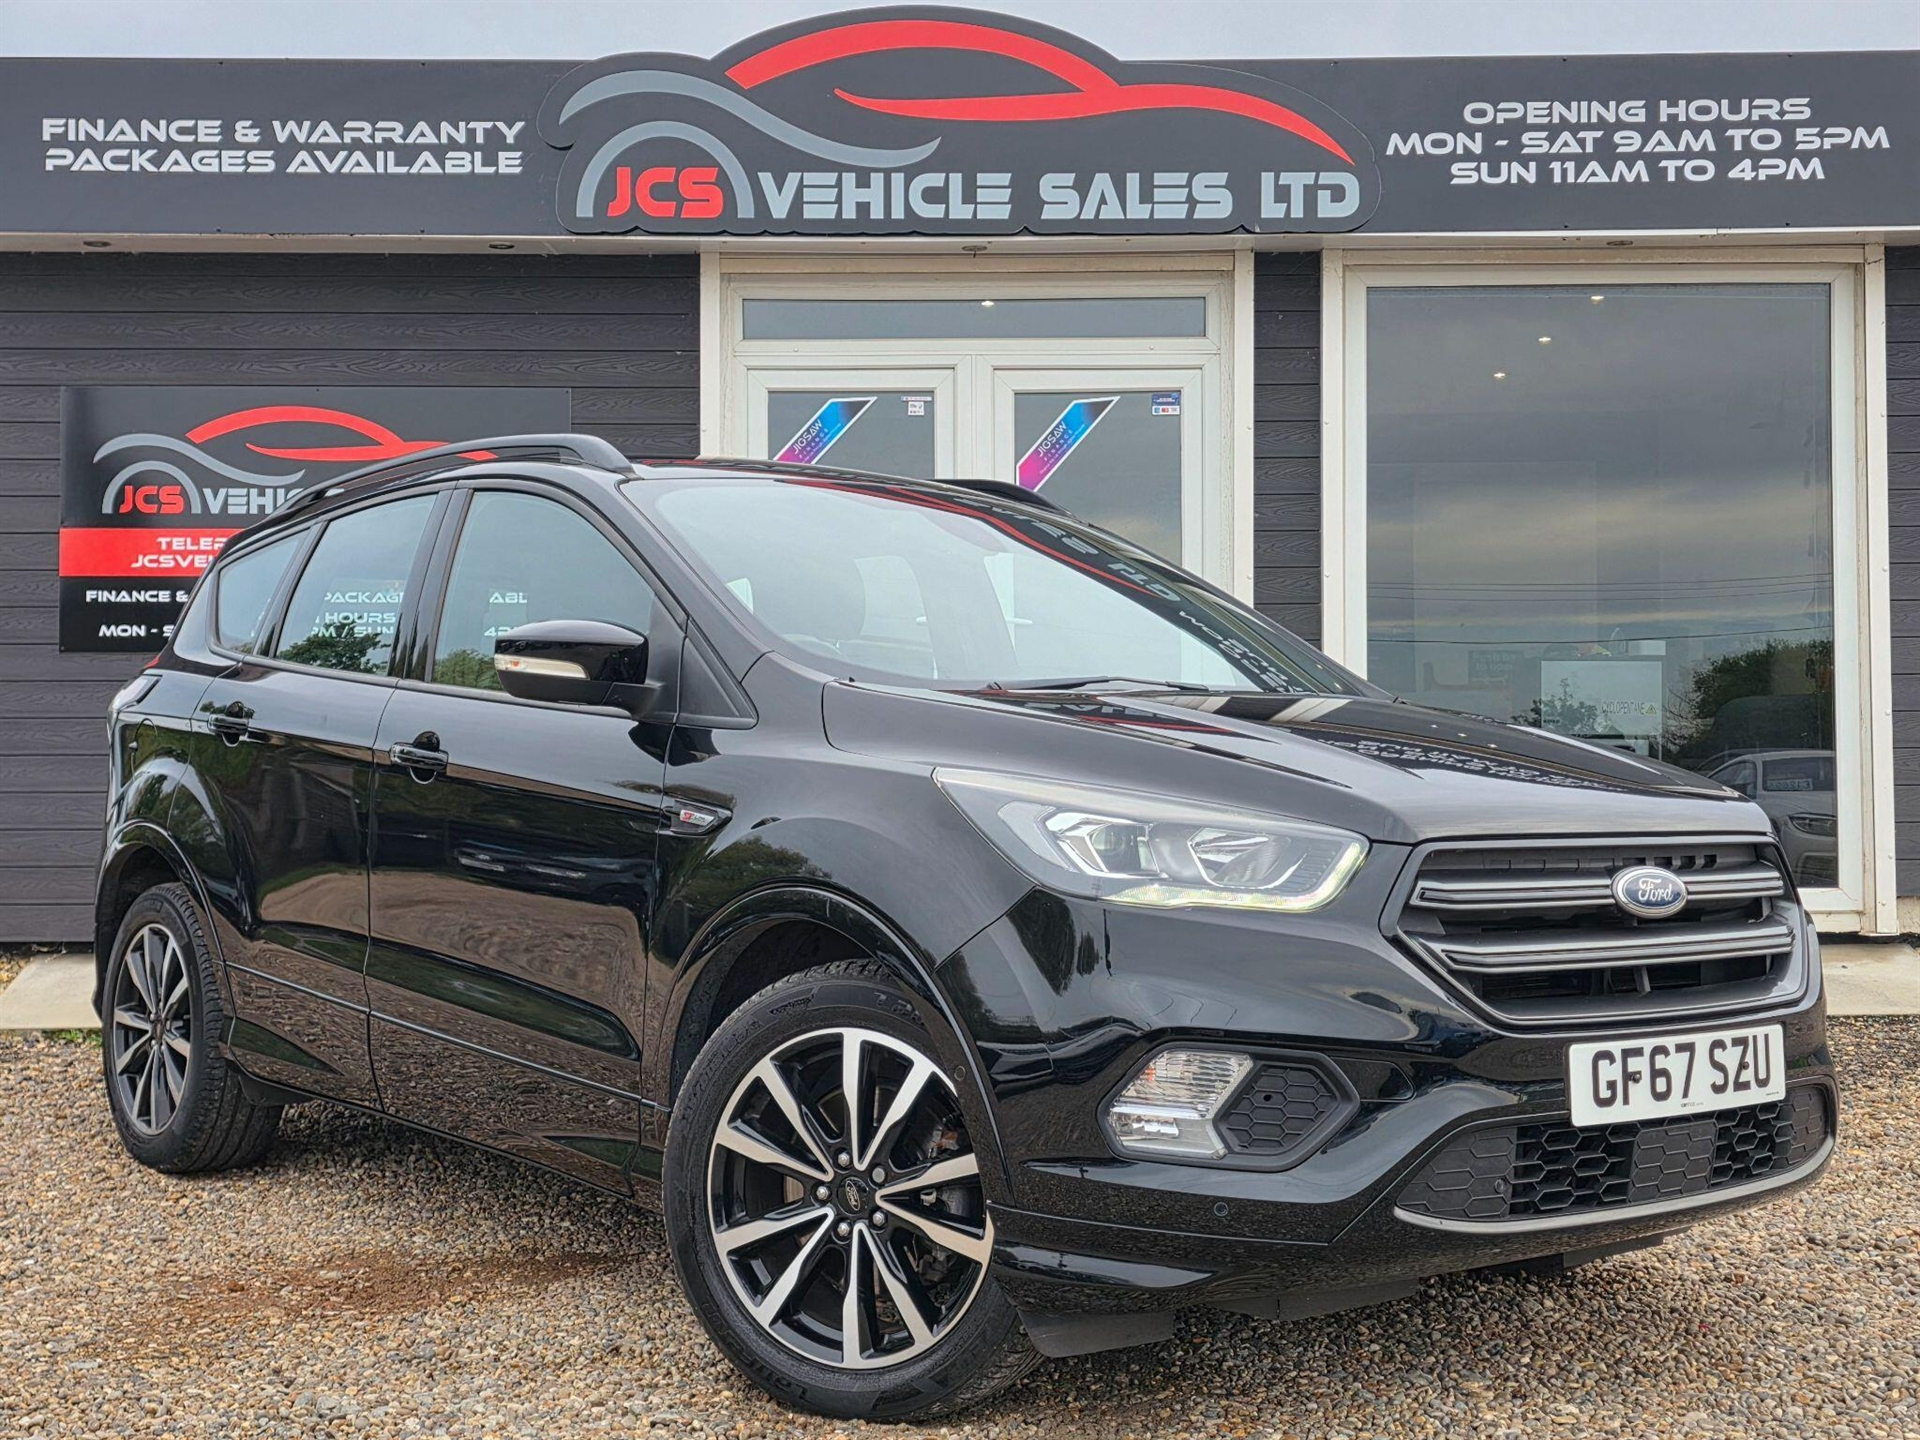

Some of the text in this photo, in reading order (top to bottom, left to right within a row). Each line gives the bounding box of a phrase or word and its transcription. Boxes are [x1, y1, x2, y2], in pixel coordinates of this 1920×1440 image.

[1464, 98, 1811, 125] OPENING HOURS
[43, 118, 525, 144] FINANCE & WARRANTY
[1386, 131, 1483, 155] MON
[1522, 130, 1605, 153] SAT
[1614, 129, 1717, 152] 9AM
[1725, 128, 1782, 151] TO
[1795, 126, 1890, 149] 5PM
[46, 148, 523, 174] PACKAGES AVAILABLE
[1451, 157, 1825, 185] SUN 11AM TO 4PM
[608, 167, 1360, 220] JCS VEHICLE SALES LTD
[792, 419, 823, 455] JIGSAW
[1037, 420, 1068, 457] JIGSAW
[119, 485, 185, 515] JCS
[86, 590, 171, 603] FINANCE
[176, 591, 189, 602] &
[98, 624, 146, 637] MON
[162, 625, 174, 637] S
[325, 612, 396, 624] HOURS
[1638, 877, 1674, 903] Ford
[1591, 1033, 1772, 1109] GF67 SZU
